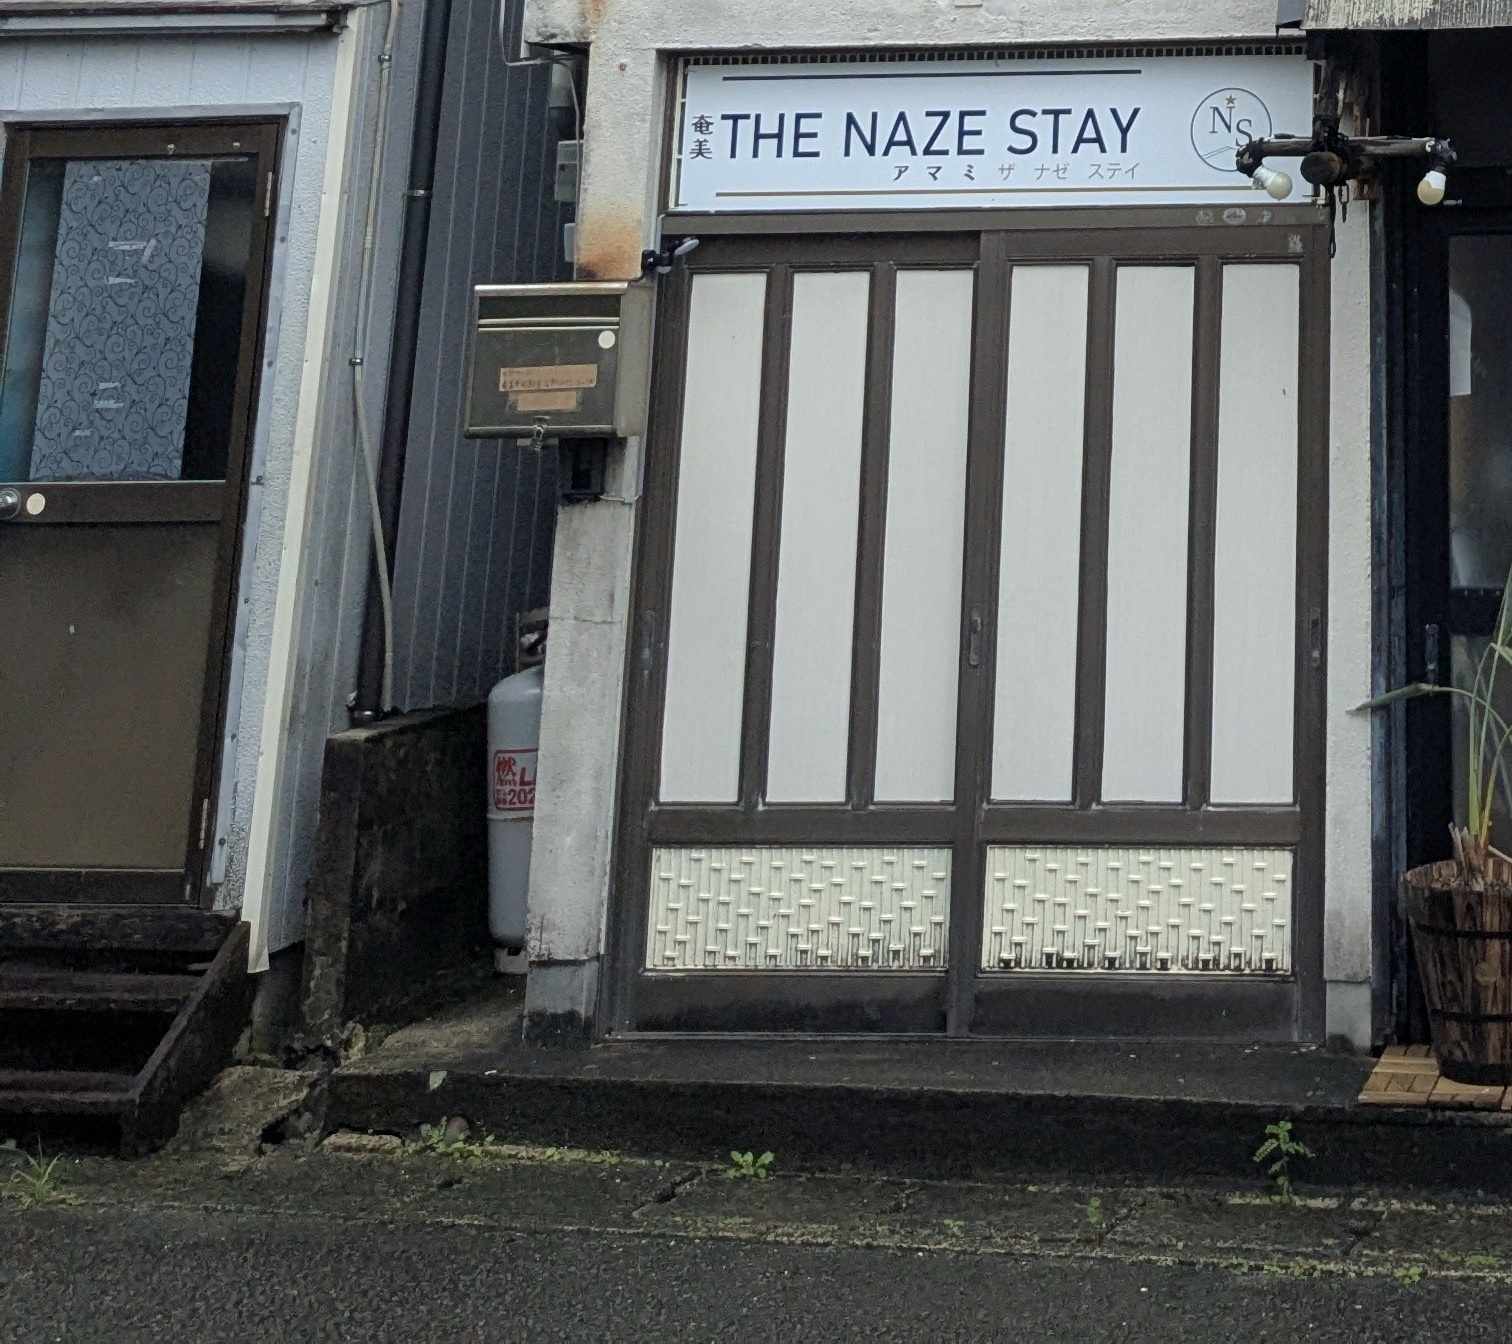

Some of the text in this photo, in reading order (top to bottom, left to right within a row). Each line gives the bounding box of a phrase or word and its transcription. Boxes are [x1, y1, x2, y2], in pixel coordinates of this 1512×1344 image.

[689, 115, 714, 160] 奄美
[720, 106, 1141, 159] THE NAZE STAY
[1087, 162, 1140, 180] ステイ
